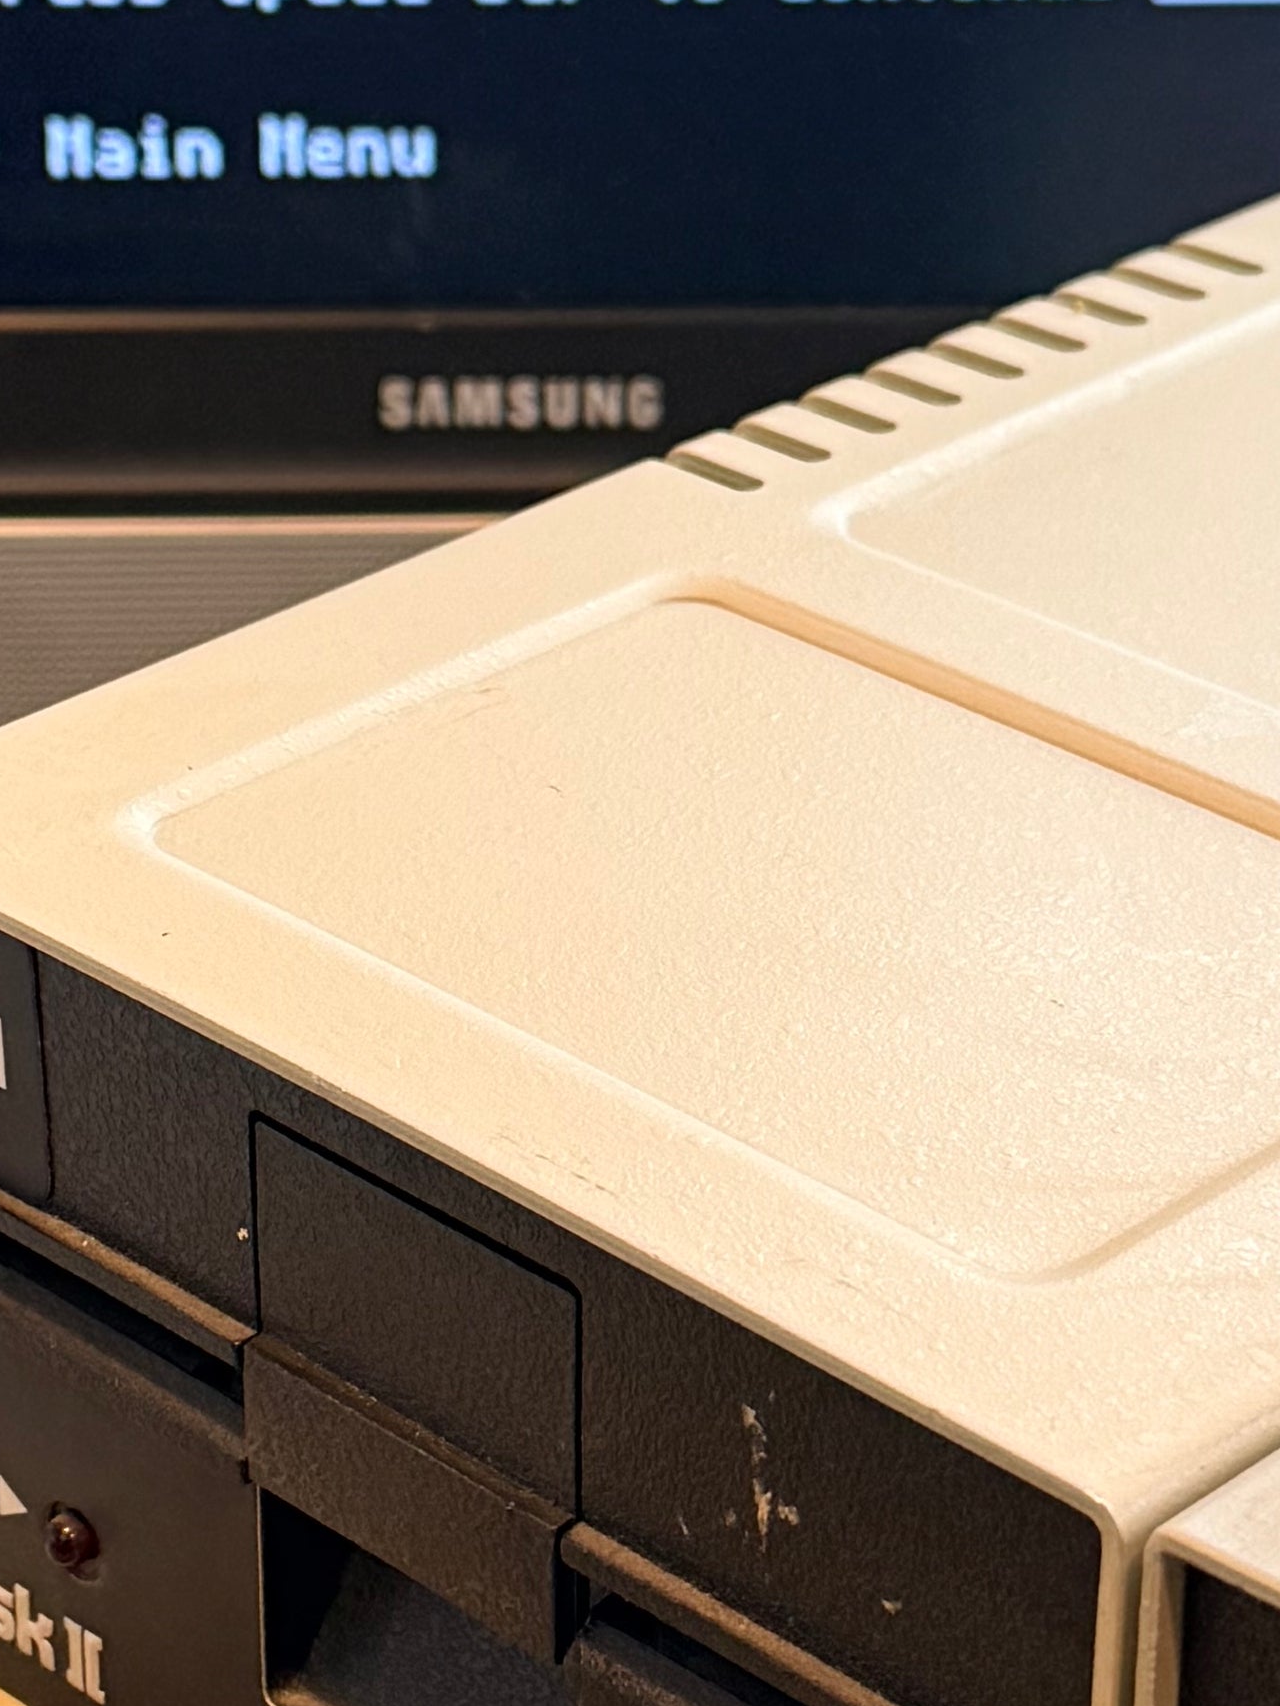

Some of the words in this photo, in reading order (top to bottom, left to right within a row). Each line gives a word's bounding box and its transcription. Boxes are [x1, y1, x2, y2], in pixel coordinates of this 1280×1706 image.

[43, 113, 226, 181] Main
[257, 113, 438, 180] Menu
[377, 375, 663, 431] SAMSUNG
